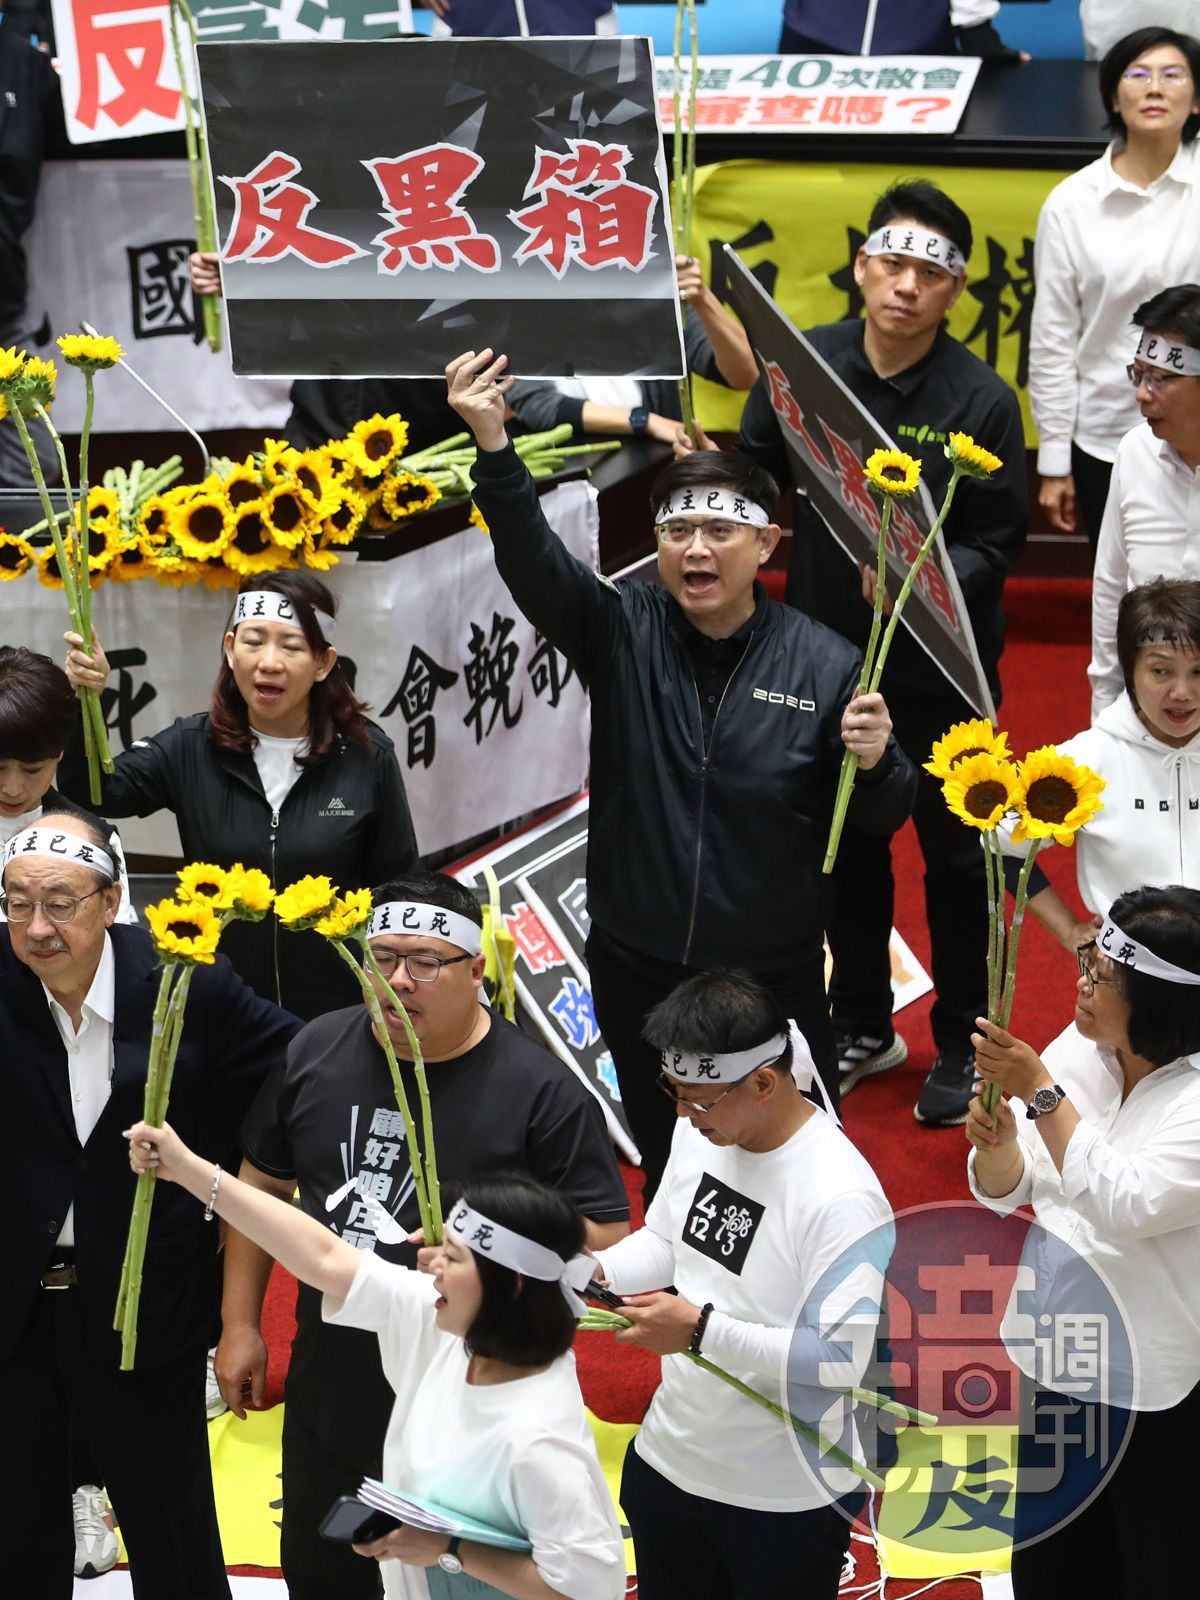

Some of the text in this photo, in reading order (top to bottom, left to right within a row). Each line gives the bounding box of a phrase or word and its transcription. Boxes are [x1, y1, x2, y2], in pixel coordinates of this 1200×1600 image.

[217, 138, 660, 281] 反黑箱
[882, 230, 957, 269] 民主已死
[1136, 335, 1185, 369] 已死
[753, 687, 816, 712] 2020
[7, 830, 95, 864] 民主已死
